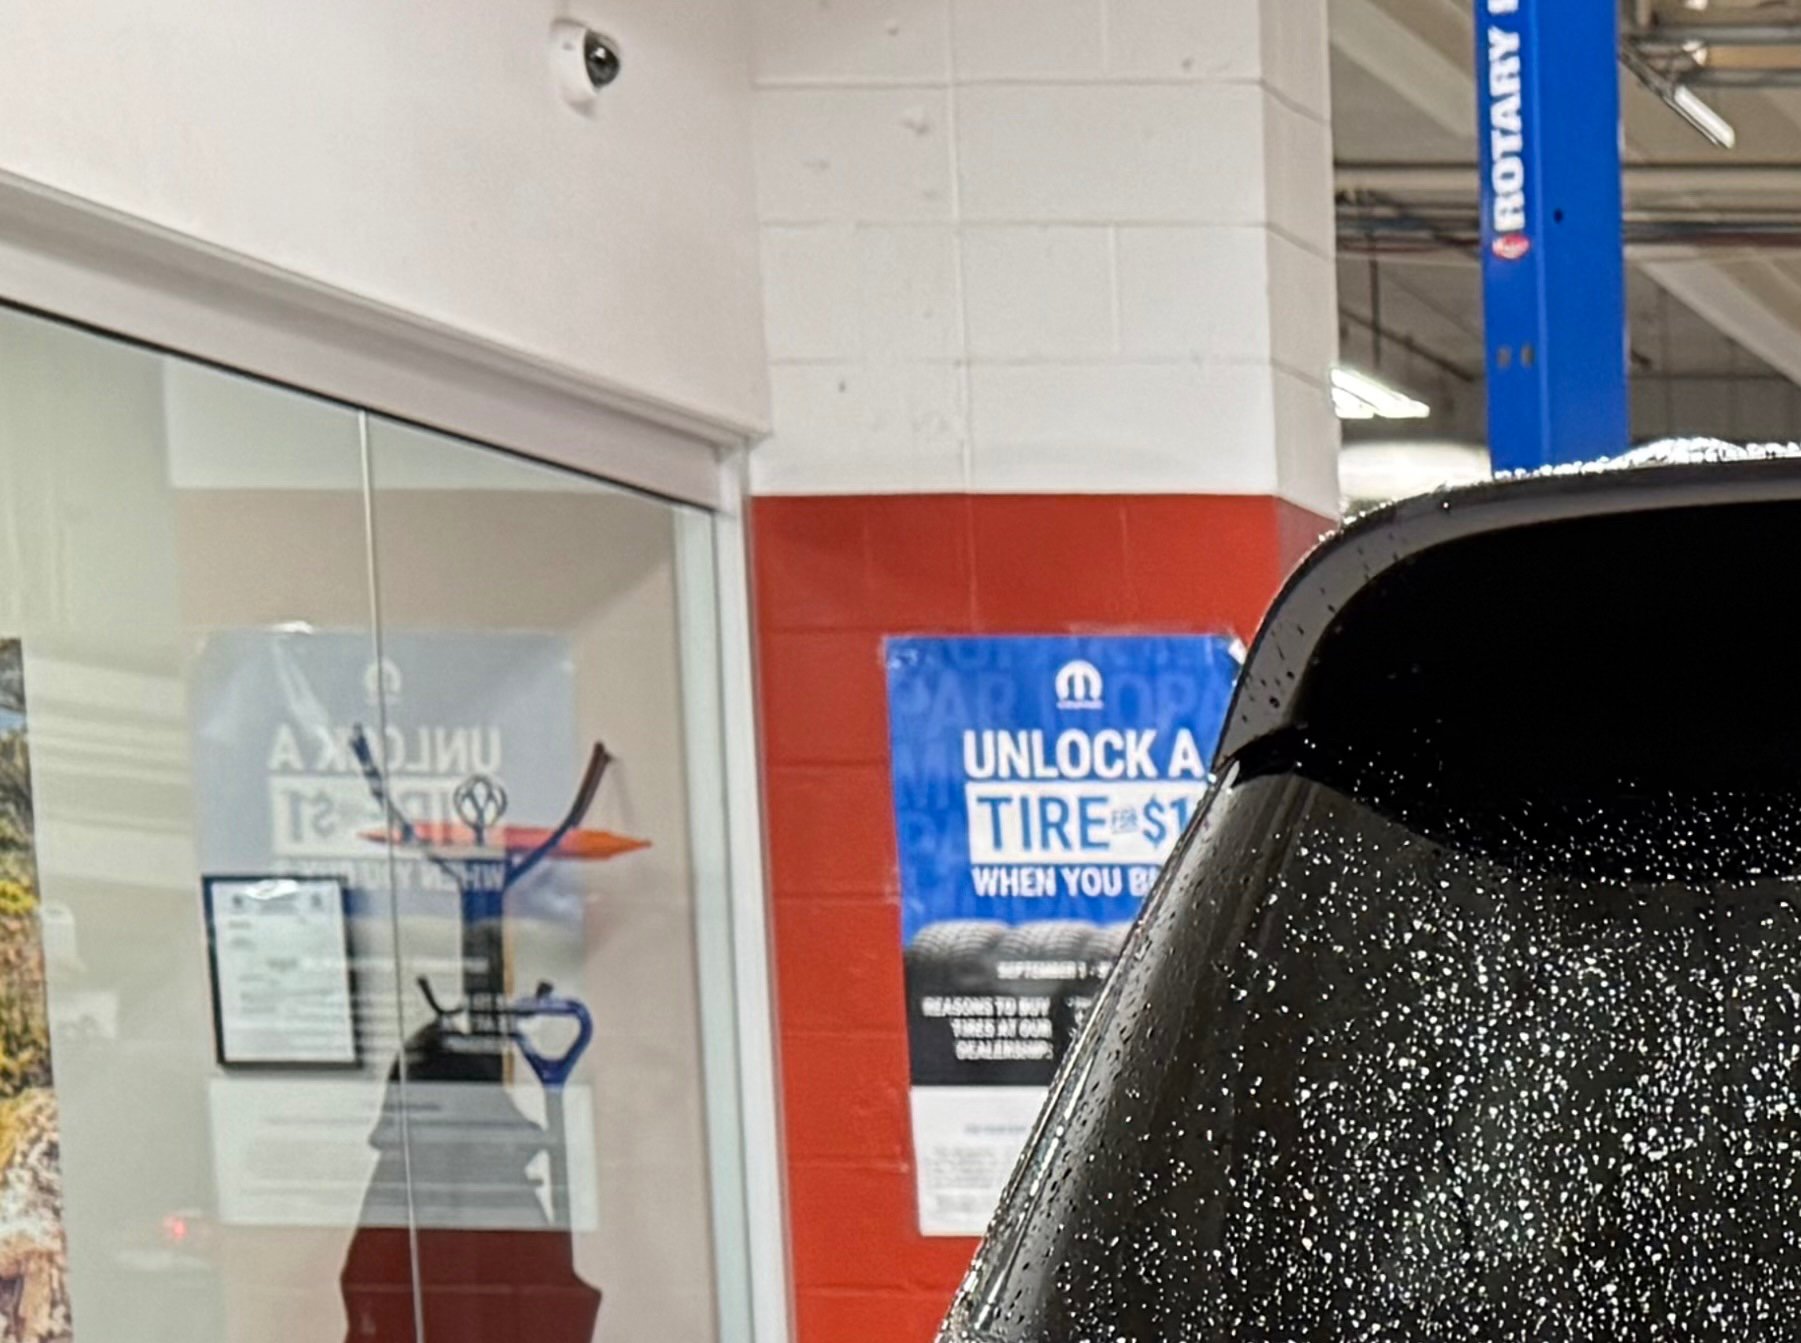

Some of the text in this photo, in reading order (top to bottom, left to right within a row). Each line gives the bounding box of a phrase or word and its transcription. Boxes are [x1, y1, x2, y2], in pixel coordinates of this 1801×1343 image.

[1488, 25, 1526, 231] ROTARY
[963, 728, 1206, 778] UNLOCK A
[976, 796, 1110, 852] TIRE
[1142, 794, 1188, 849] $1
[970, 866, 1057, 897] WHEN
[1065, 865, 1123, 896] YOU
[997, 960, 1077, 979] SEPTEMBER
[922, 996, 1051, 1017] REASONS TO BUY
[950, 1018, 1052, 1038] TIRES AT OUR
